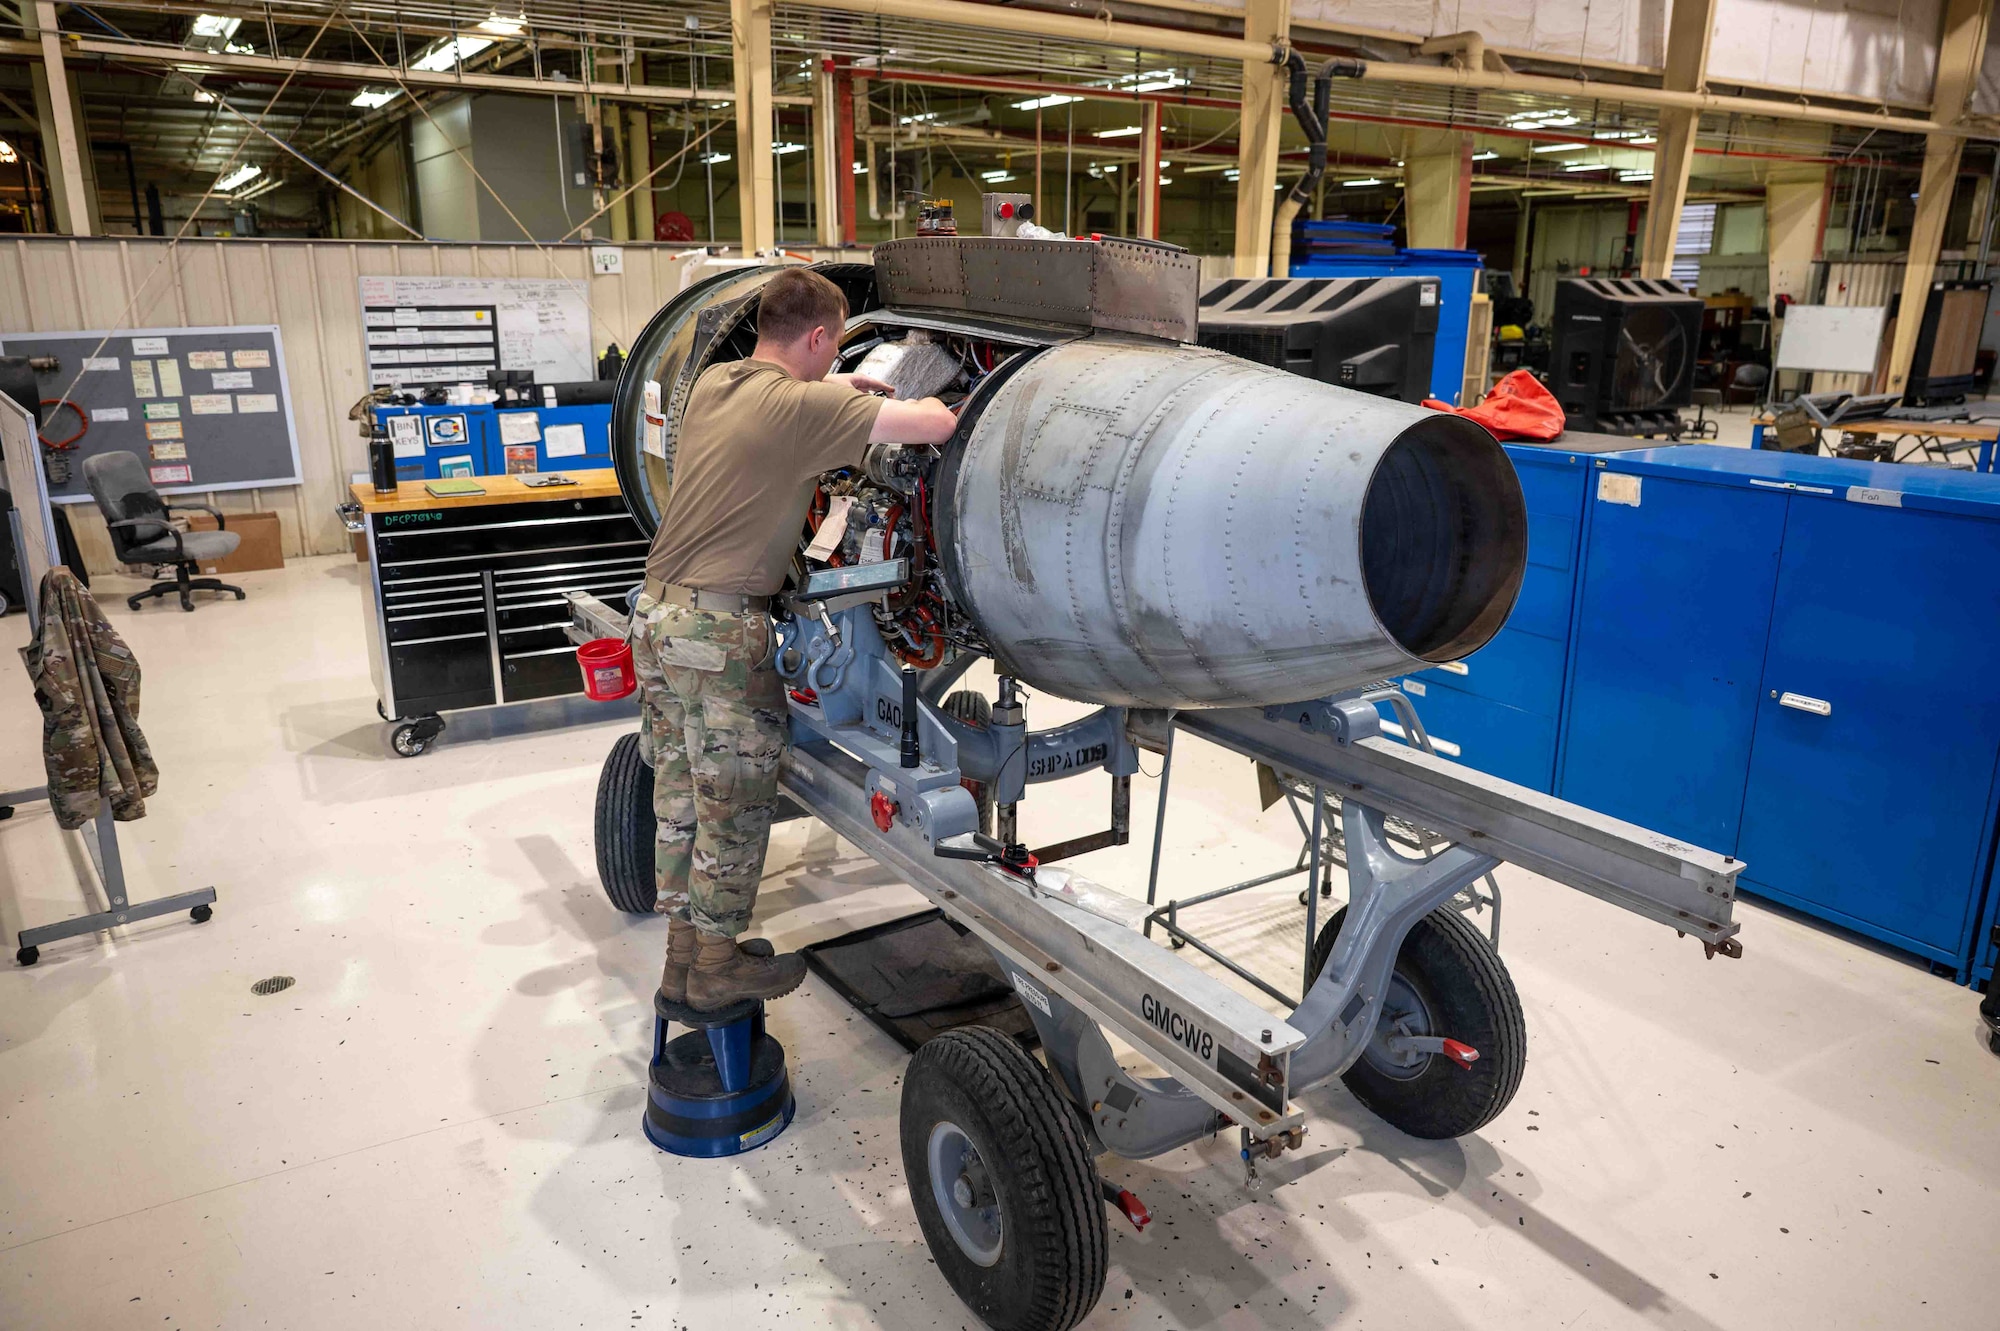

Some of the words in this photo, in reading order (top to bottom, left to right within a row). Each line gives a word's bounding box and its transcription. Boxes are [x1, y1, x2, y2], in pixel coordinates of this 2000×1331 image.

[596, 254, 618, 265] AED
[396, 423, 414, 431] BIN
[395, 436, 420, 446] KEYS
[1861, 490, 1880, 501] Fan
[1142, 993, 1214, 1061] GMCW8
